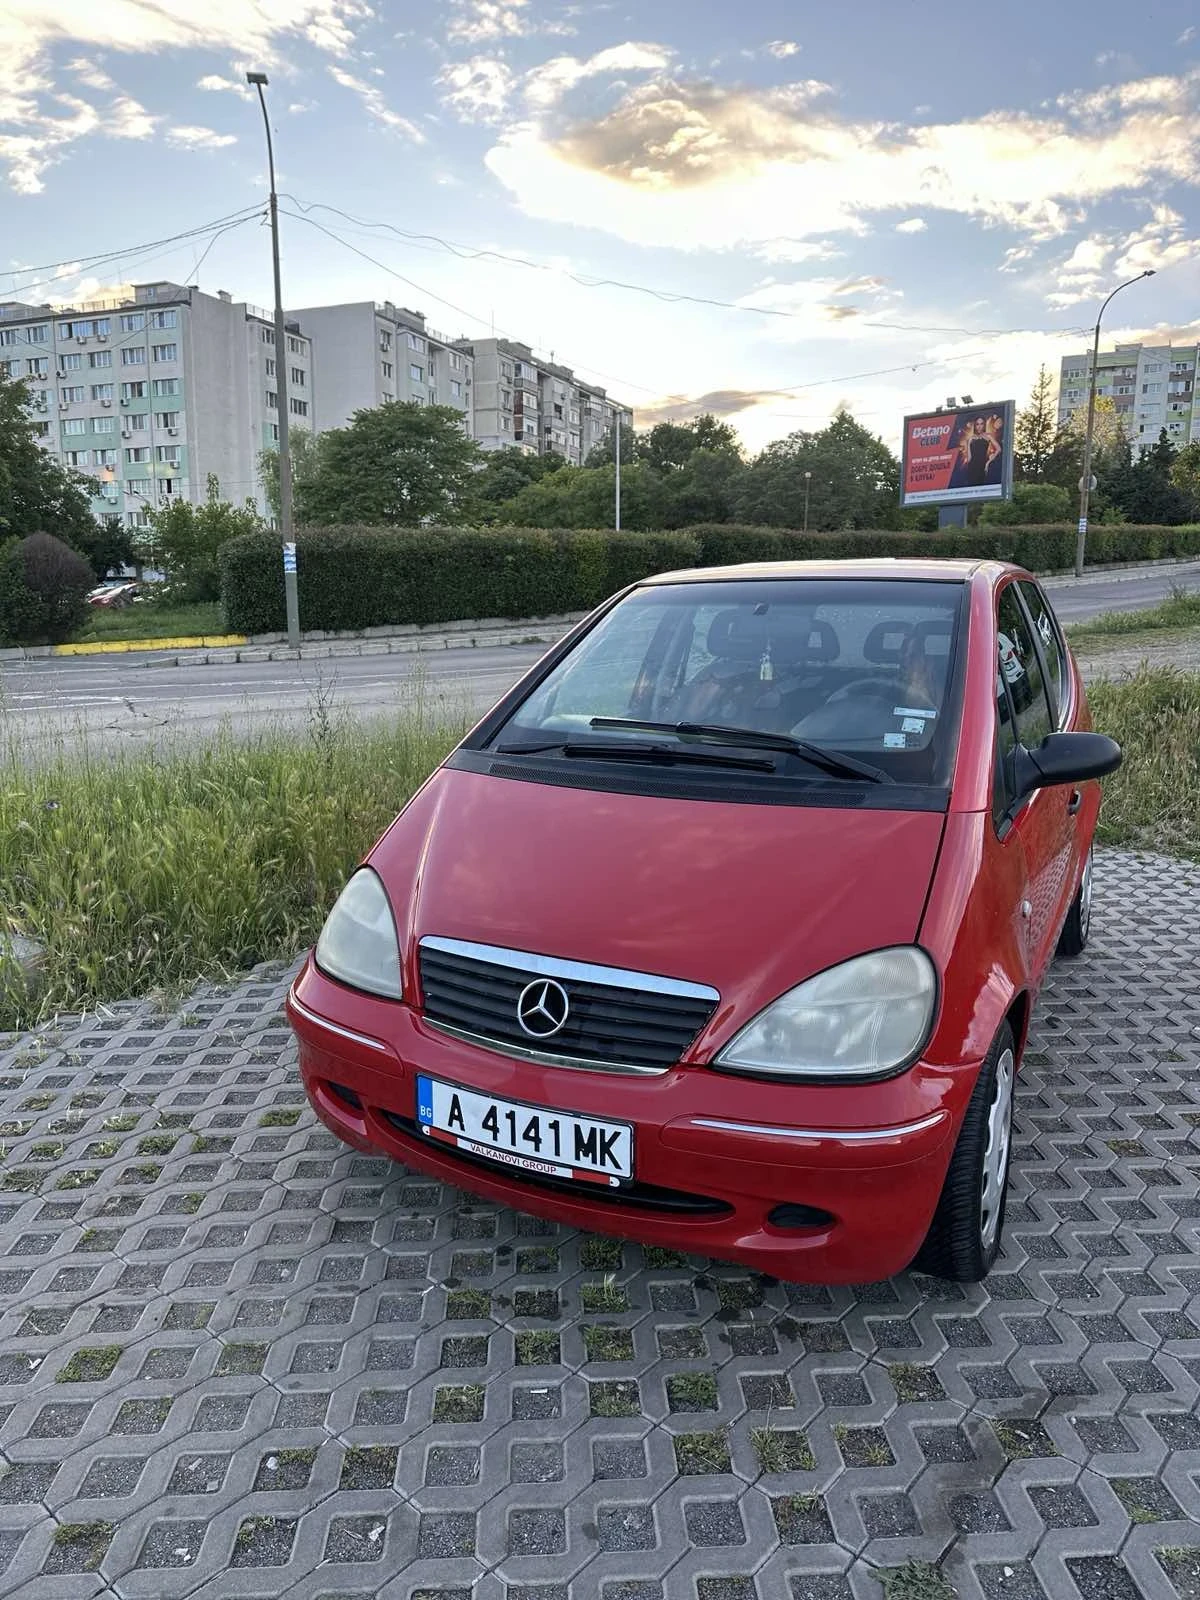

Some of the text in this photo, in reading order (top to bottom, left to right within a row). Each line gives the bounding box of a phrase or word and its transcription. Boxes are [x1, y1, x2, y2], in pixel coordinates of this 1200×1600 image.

[912, 425, 950, 439] Betano
[420, 1105, 432, 1118] BG
[448, 1094, 622, 1170] A 4141 MK
[470, 1144, 557, 1174] VALKANOVI GROUP
